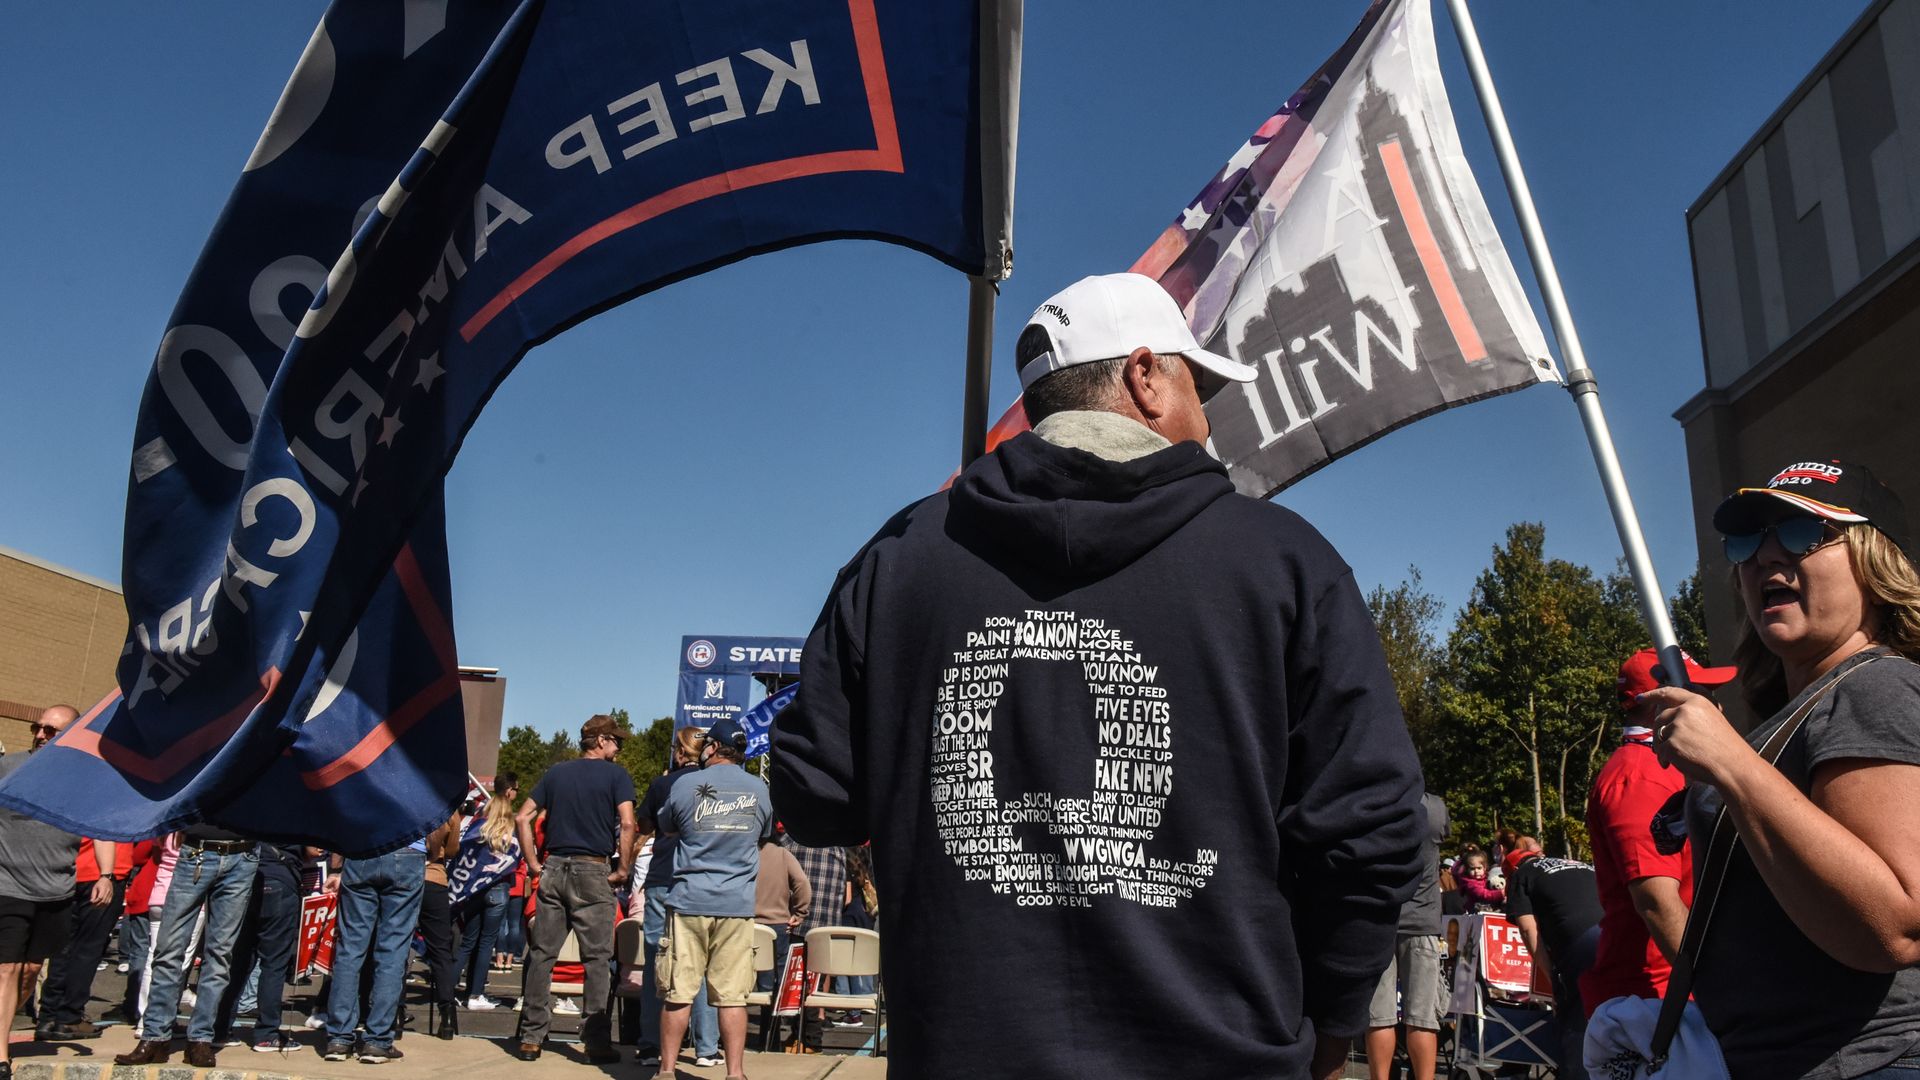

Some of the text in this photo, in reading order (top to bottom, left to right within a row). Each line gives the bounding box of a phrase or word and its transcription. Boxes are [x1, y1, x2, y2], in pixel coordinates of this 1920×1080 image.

[1043, 304, 1070, 327] TRUMP
[1769, 477, 1812, 489] 2020
[985, 617, 1016, 628] BOOM
[1024, 610, 1075, 621] TRUTH
[1080, 619, 1104, 629] YOU
[967, 629, 1010, 647] PAIN!
[1014, 621, 1077, 648] #QANON
[1080, 629, 1120, 640] HAVE
[1079, 639, 1133, 651] MORE
[729, 646, 802, 663] STATE
[953, 647, 1075, 663] THE GREAT AWAKENING
[1076, 650, 1141, 663] THAN
[943, 663, 1009, 683] UP IS DOWN
[1083, 662, 1158, 683] YOU KNOW
[938, 681, 1004, 702] BE LOUD
[1088, 683, 1167, 699] TIME TO FEED
[957, 700, 972, 711] THE
[973, 698, 998, 710] SHOW
[1095, 697, 1170, 725] FIVE EYES
[933, 708, 992, 737] BOOM
[951, 734, 965, 751] THE
[967, 732, 988, 750] PLAN
[1099, 721, 1171, 750] NO DEALS
[931, 751, 967, 763] FUTURE
[1101, 746, 1173, 762] BUCKLE UP
[931, 763, 967, 775] PROVES
[967, 750, 994, 779] SR
[931, 773, 966, 785] PAST
[1095, 759, 1173, 796] FAKE NEWS
[953, 782, 966, 800] NO
[968, 780, 994, 800] MORE
[695, 793, 756, 822] Old Guys Rule
[934, 798, 998, 813] TOGETHER
[1005, 801, 1022, 810] NO
[1023, 792, 1052, 808] SUCH
[1053, 798, 1090, 812] AGENCY
[1093, 791, 1167, 809] DARK TO LIGHT
[937, 809, 1054, 828] PATRIOTS IN CONTROL
[1056, 812, 1091, 824] HRC
[1092, 803, 1161, 828] STAY UNITED
[938, 825, 1013, 840] THESE PEOPLE ARE SICK
[1049, 824, 1154, 840] EXPAND YOUR THINKING
[945, 837, 1022, 855] SYMBOLISM
[954, 853, 1060, 867] WE STAND WITH YOU
[1197, 848, 1218, 865] BOOM
[965, 864, 1098, 882] BOOM ENOUGH IS ENOUGH
[1150, 858, 1214, 877] BAD ACTORS
[1100, 865, 1206, 889] LOGICAL THINKING
[991, 882, 1115, 895] WE WILL SHINE LIGHT
[1116, 879, 1141, 903] TRUST
[1141, 883, 1193, 899] SESSIONS
[1016, 895, 1093, 908] GOOD VS EVIL
[1141, 895, 1177, 908] HUBER
